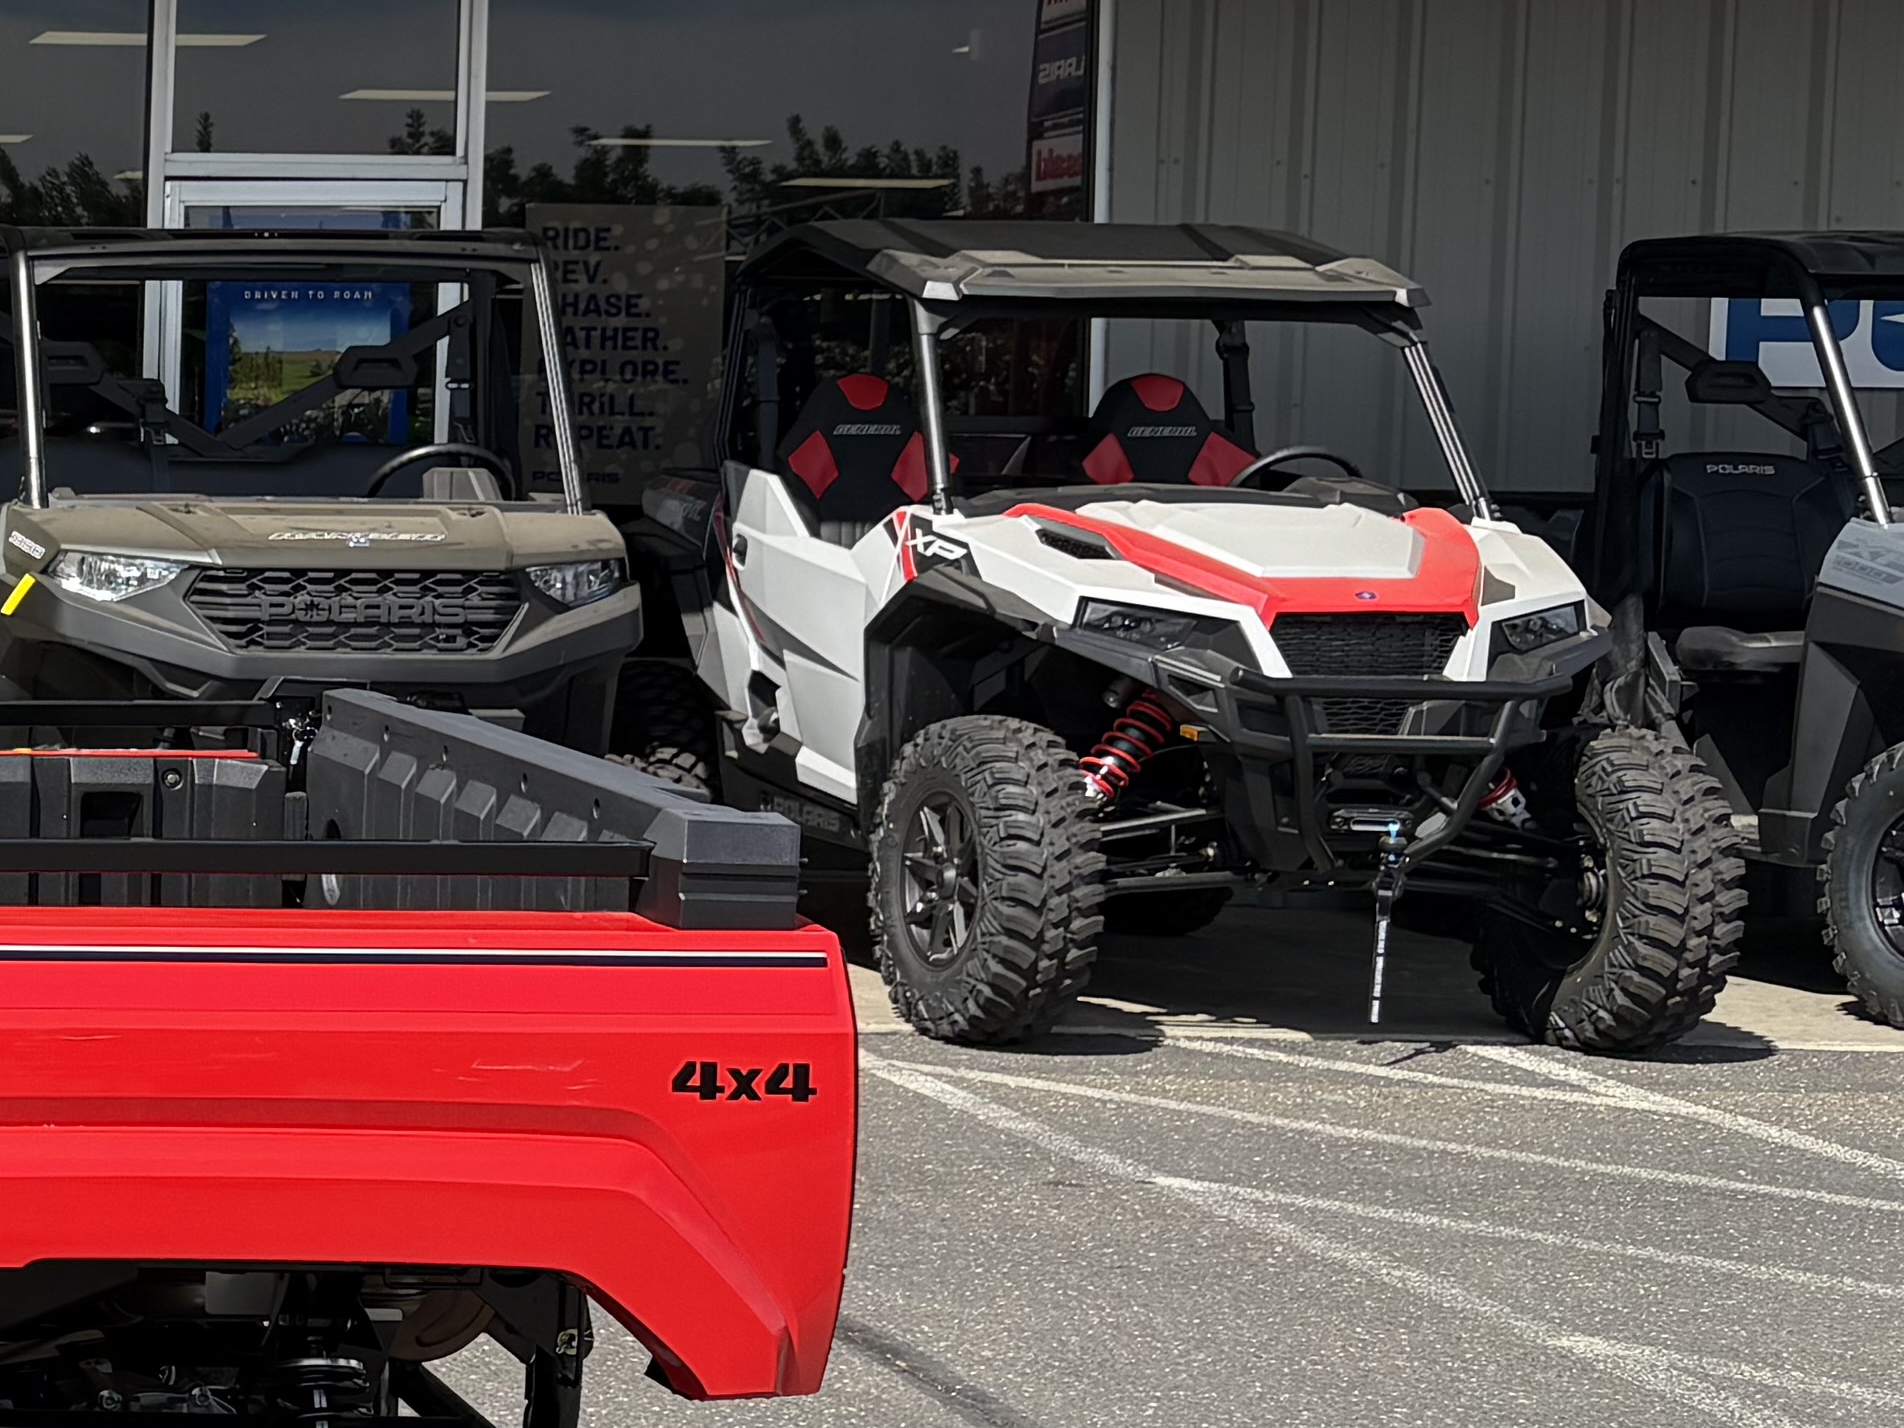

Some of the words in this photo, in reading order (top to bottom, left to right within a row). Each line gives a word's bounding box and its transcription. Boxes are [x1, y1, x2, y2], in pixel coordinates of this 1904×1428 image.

[541, 226, 620, 251] RIDE.
[553, 259, 609, 284] EV.
[243, 290, 300, 301] DRIVEN
[308, 290, 325, 301] TO
[334, 290, 374, 301] ROAM
[560, 293, 651, 318] HASE.
[563, 326, 669, 351] ATHER.
[537, 359, 689, 384] PLORE.
[535, 391, 655, 417] TRILL.
[533, 425, 662, 451] RPEAT.
[1706, 464, 1776, 476] POLARIS
[906, 527, 968, 560] XP
[260, 596, 468, 624] POLARIS
[670, 1060, 818, 1103] 4x4
